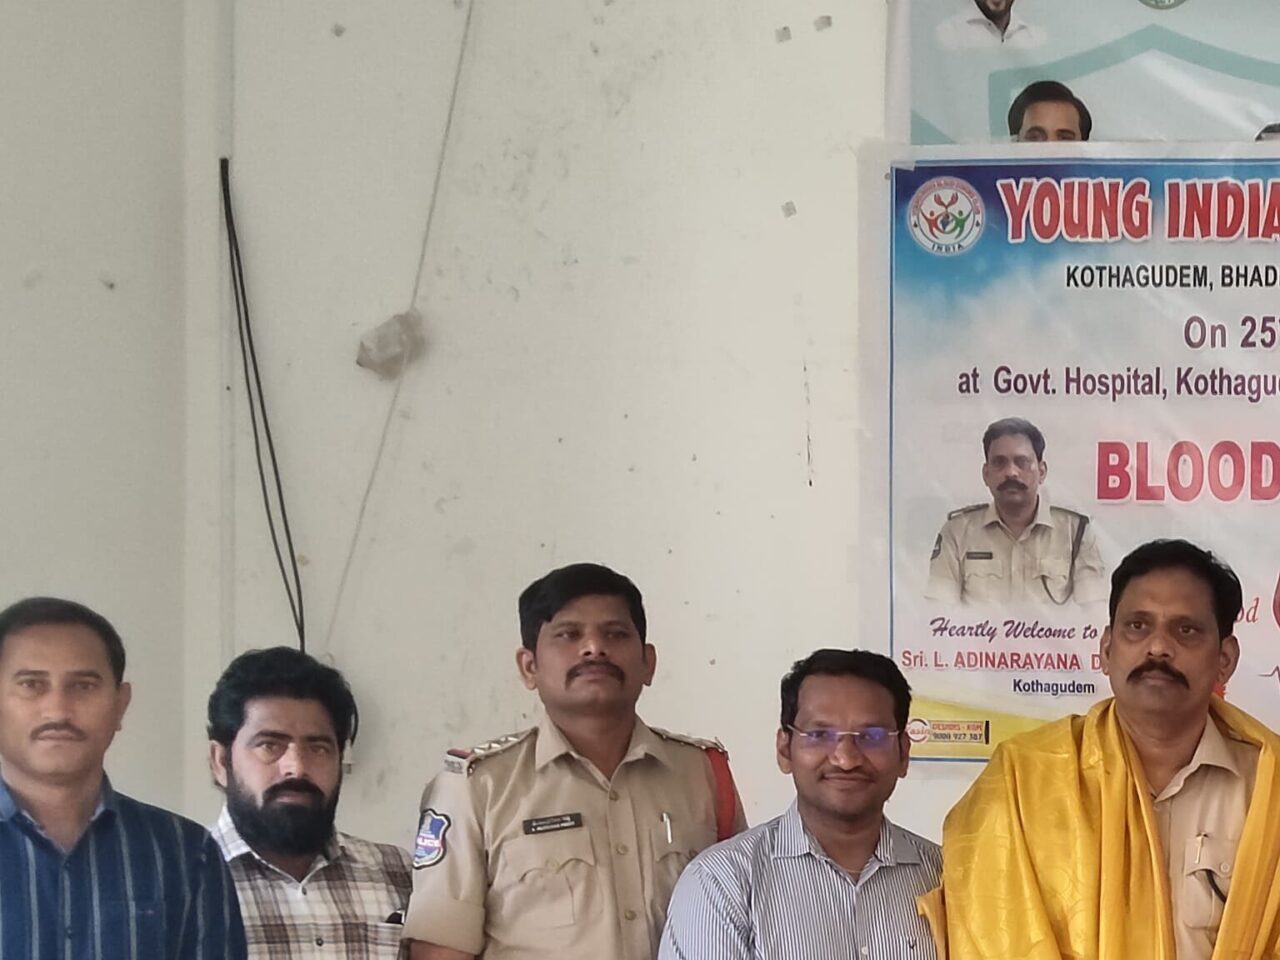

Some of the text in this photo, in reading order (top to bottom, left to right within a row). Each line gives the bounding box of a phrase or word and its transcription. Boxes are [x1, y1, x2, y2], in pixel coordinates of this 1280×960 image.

[998, 179, 1150, 241] YOUNG
[1066, 264, 1213, 290] KOTHAGUDEM,
[1184, 315, 1227, 349] On
[958, 367, 980, 394] at
[993, 366, 1056, 395] Govt.
[1065, 366, 1168, 402] Hospital,
[930, 617, 1098, 643] Heartly Welcome to
[901, 650, 928, 668] Sri.
[934, 652, 949, 668] L.
[954, 652, 1081, 670] ADINARAYANA
[1013, 679, 1095, 697] Kothagudem
